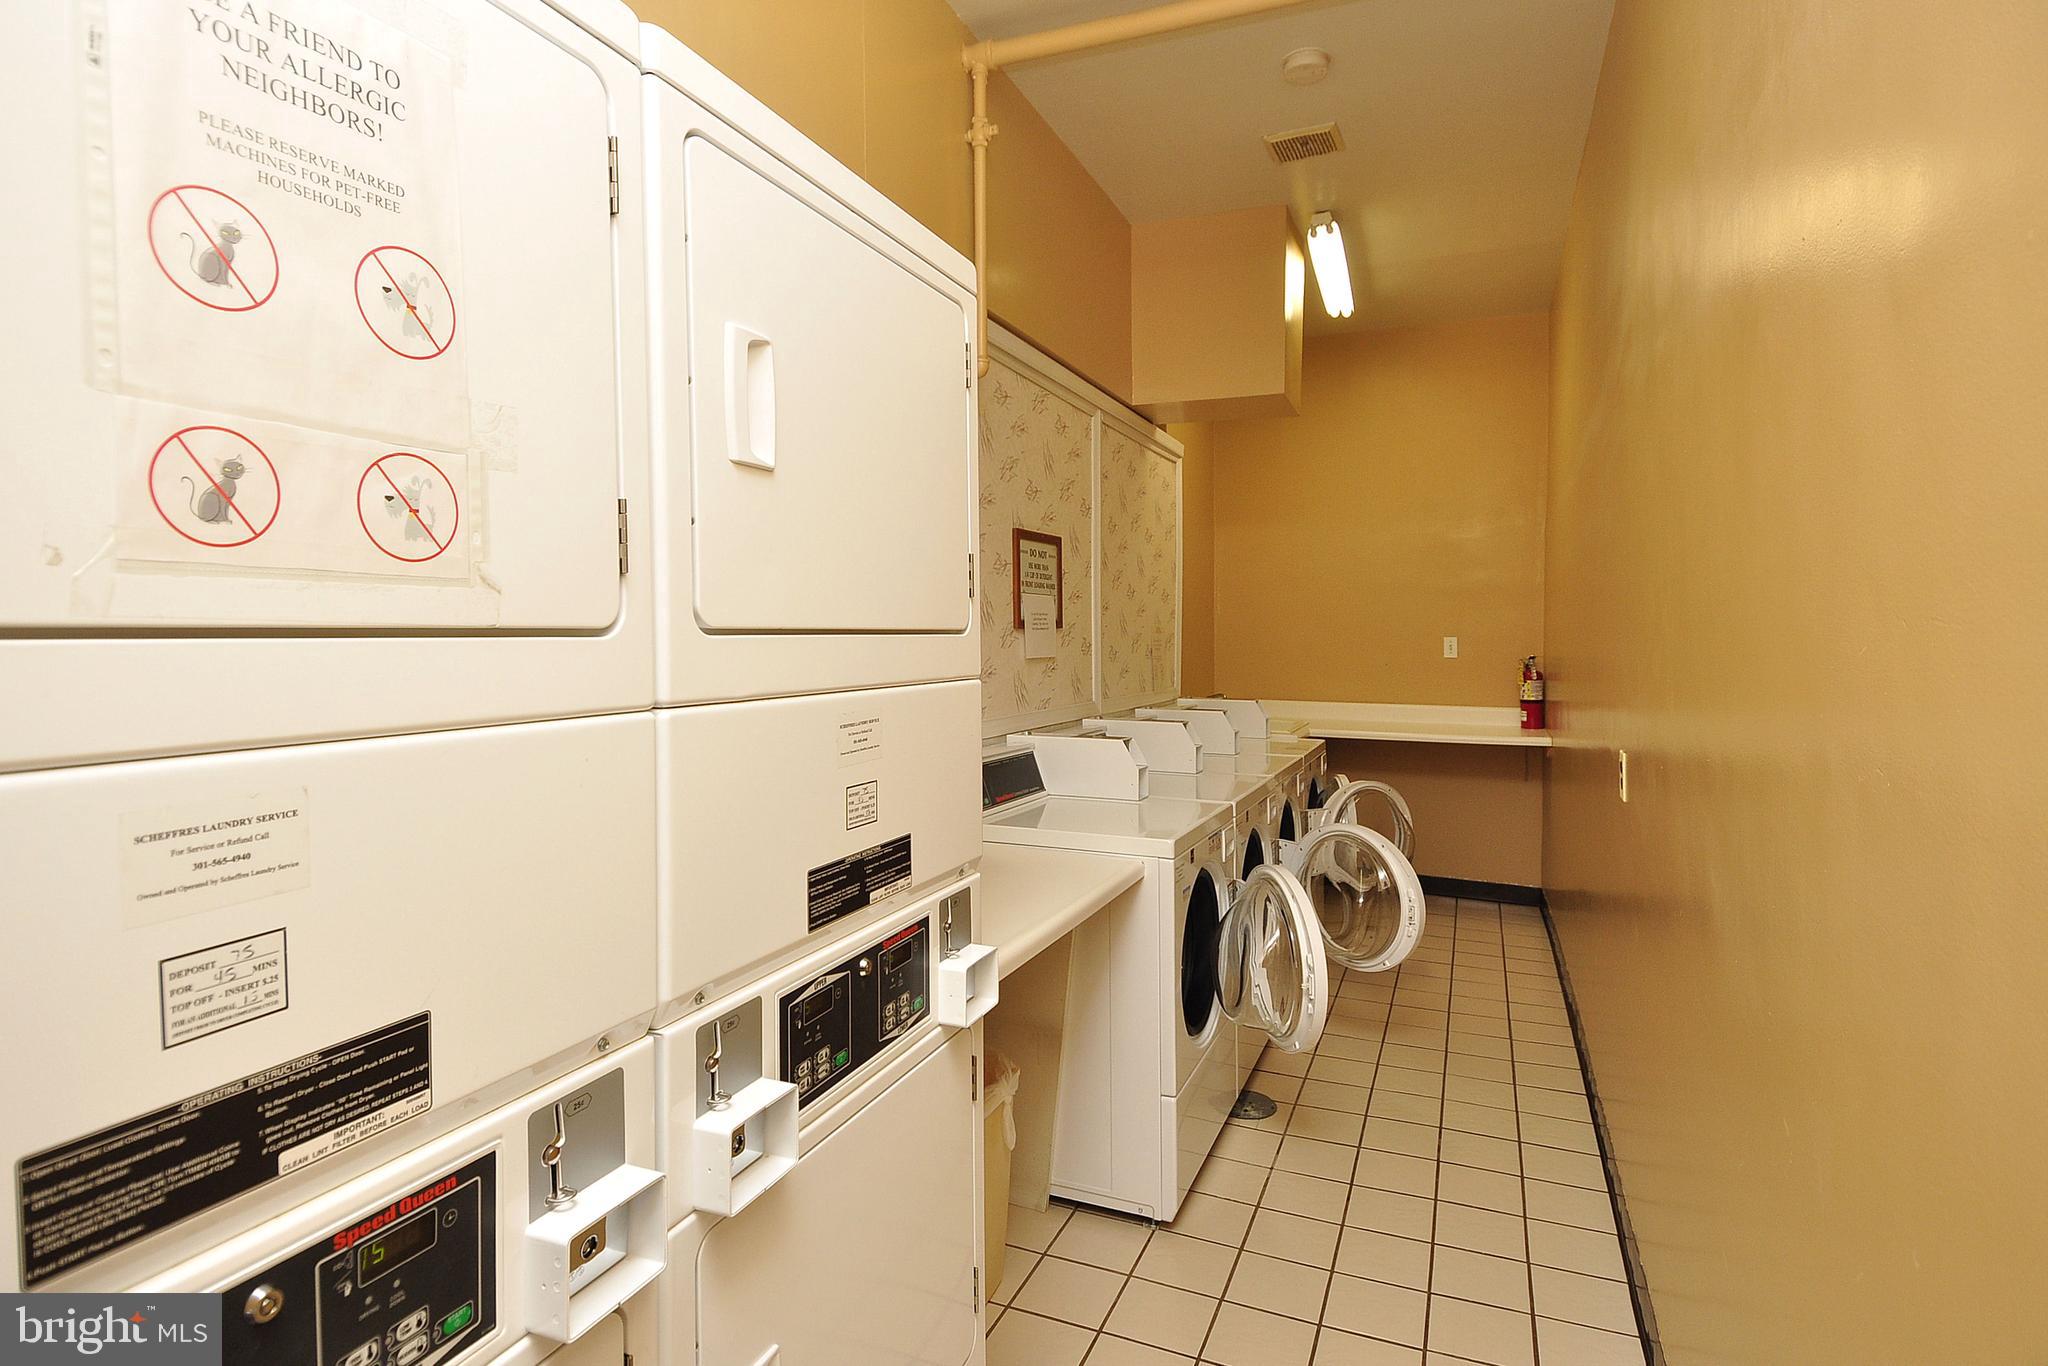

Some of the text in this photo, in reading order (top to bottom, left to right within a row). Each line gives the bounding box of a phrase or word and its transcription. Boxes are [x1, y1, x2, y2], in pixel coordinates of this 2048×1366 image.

[189, 7, 406, 121] YOUR ALLERGIC
[240, 2, 400, 90] A FRIEND TO
[220, 53, 383, 142] NEIGHBORS!
[199, 110, 405, 198] PLEASE RESERVE MARKED
[206, 132, 400, 214] MACHINES FOR PET-FREE
[257, 170, 362, 217] HOUSEHOLDS
[133, 808, 299, 846] SCHEFFRES LAUNDRY SERVICE
[170, 831, 270, 858] For Service or Refund Call
[136, 890, 162, 902] Owned
[178, 879, 208, 894] Operated
[220, 872, 250, 883] Scheffres
[250, 864, 277, 877] Laundry
[277, 861, 300, 872] Service
[191, 852, 252, 871] 301-565-4940
[168, 960, 217, 981] DEPOSIT
[168, 984, 193, 998] FOR
[252, 958, 278, 974] MINS
[170, 1000, 192, 1015] TOP
[193, 993, 215, 1007] OFF
[224, 979, 261, 998] INSERT
[378, 1052, 398, 1065] START
[281, 1101, 430, 1172] CLEAN LINT FILTER BEFORE EACH LOAD
[333, 1112, 385, 1140] IMPORTANT:
[332, 1174, 459, 1252] Speed Queen
